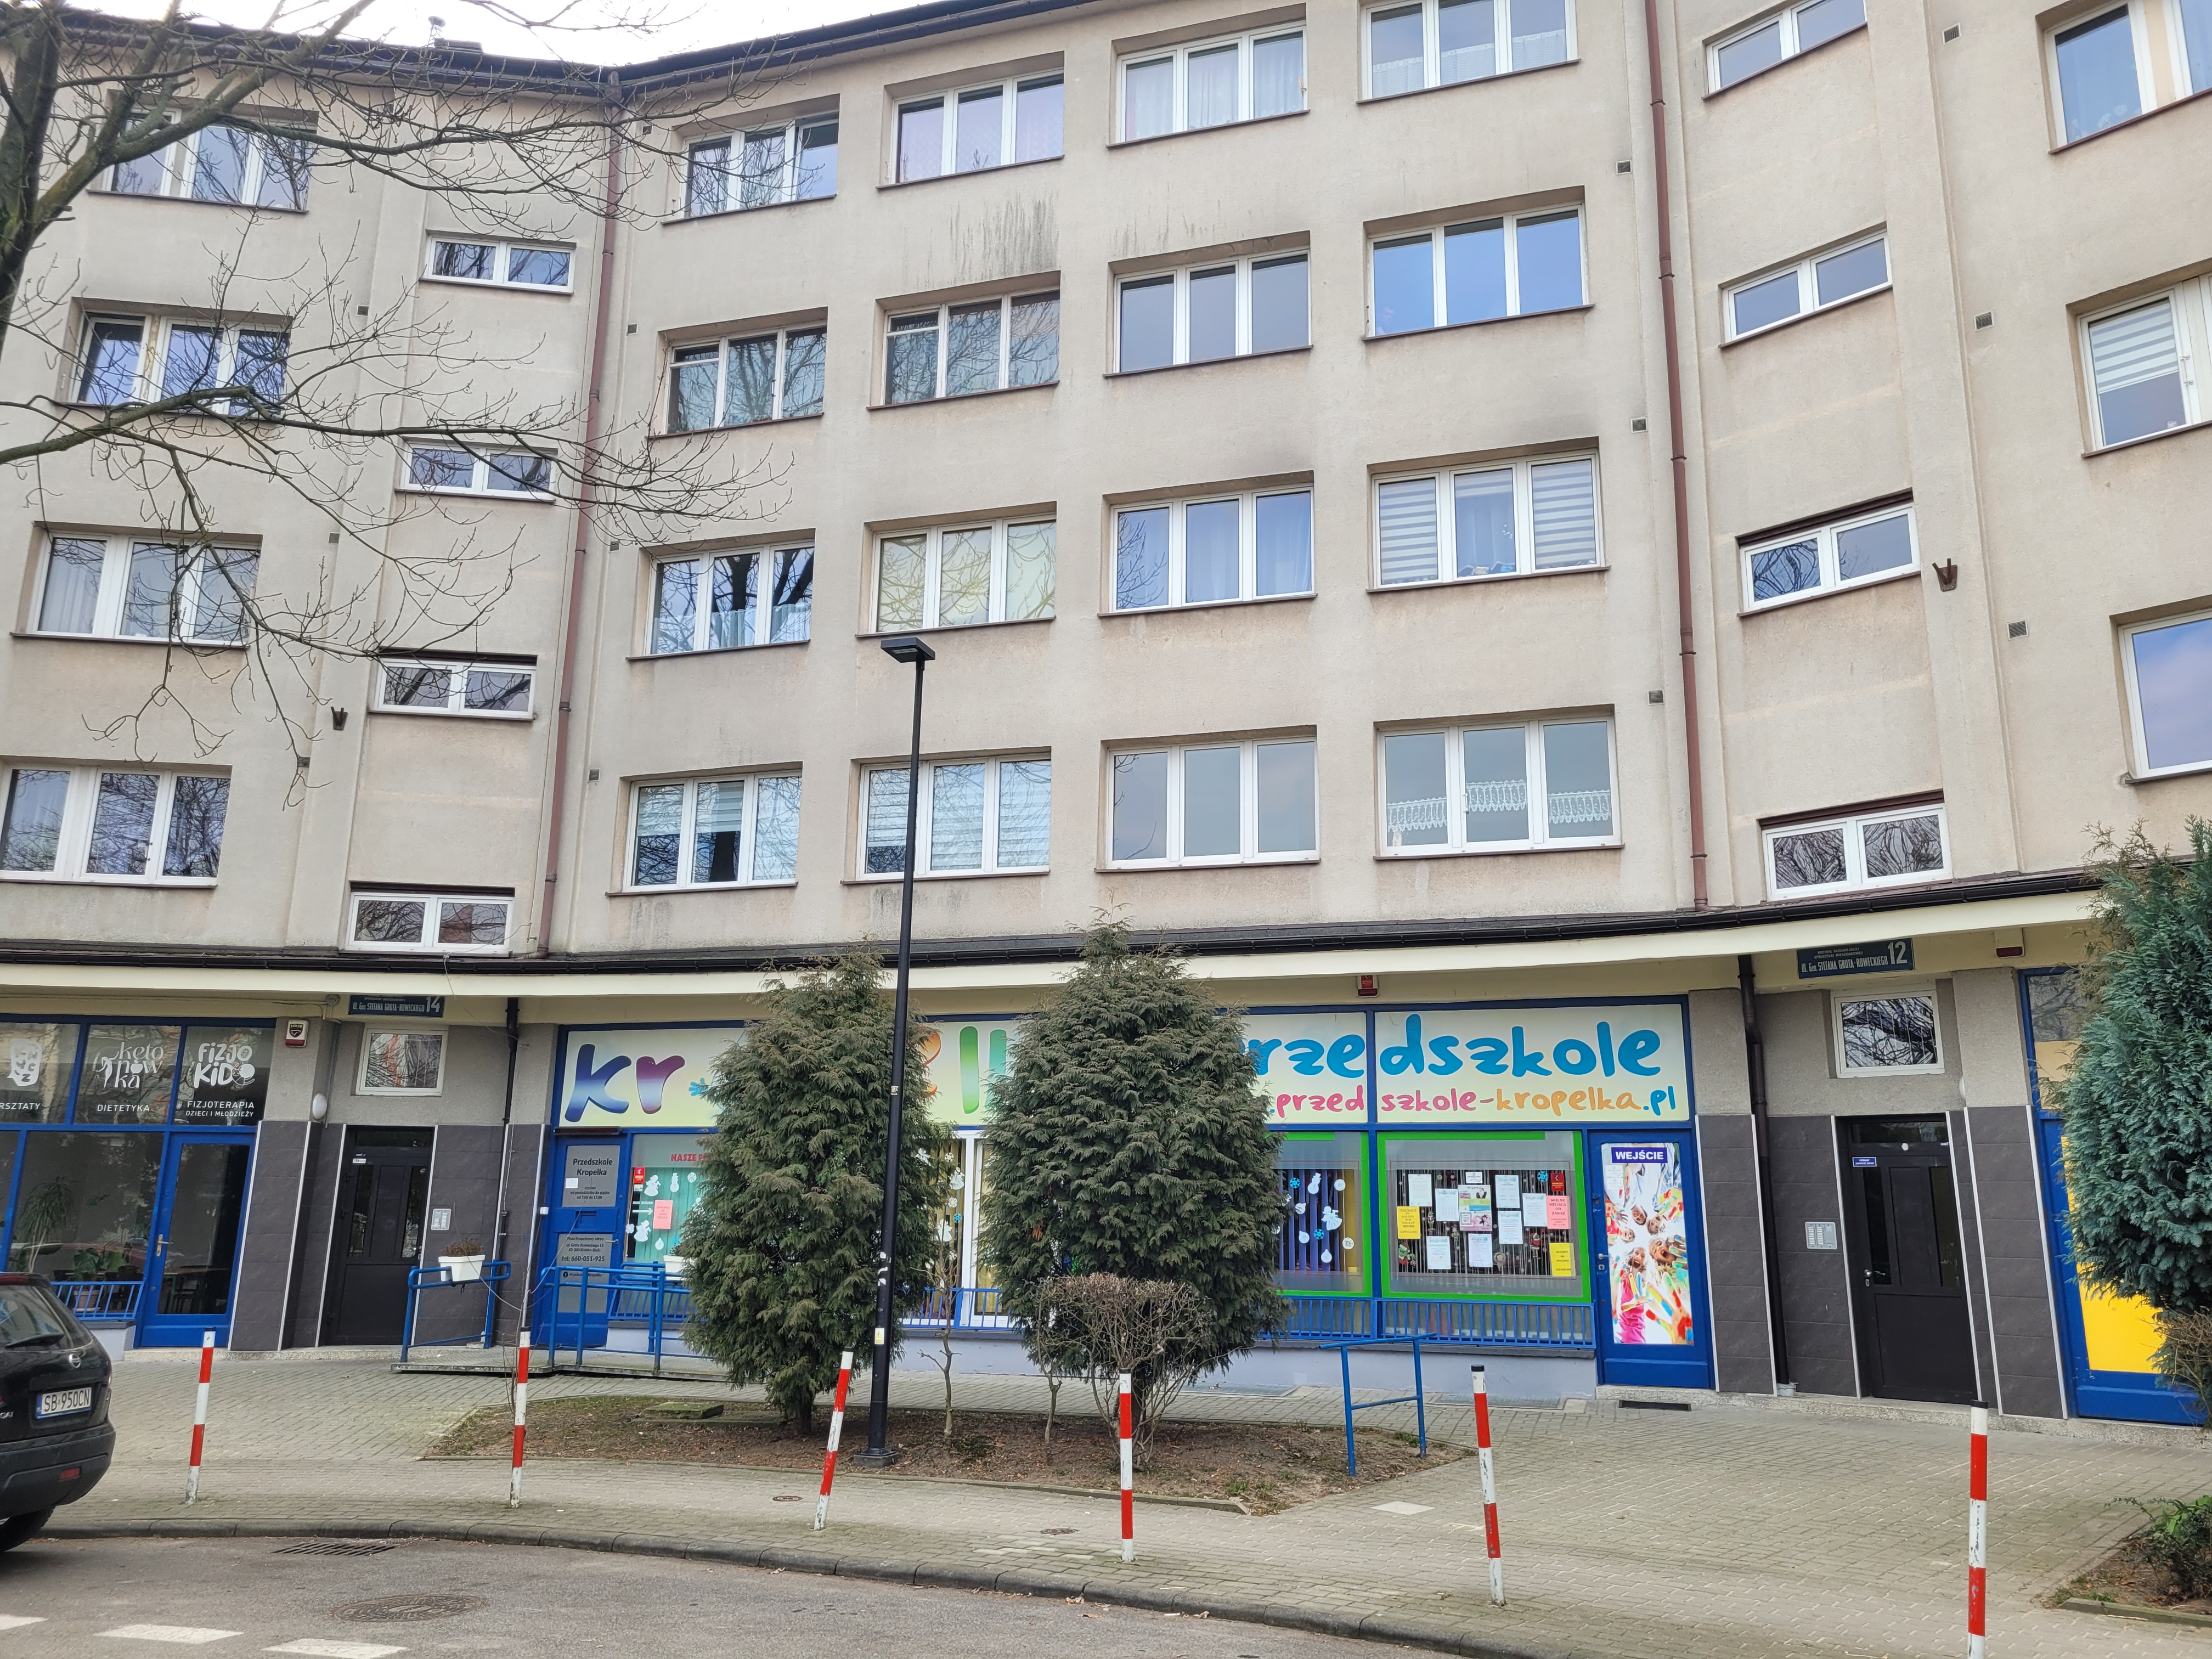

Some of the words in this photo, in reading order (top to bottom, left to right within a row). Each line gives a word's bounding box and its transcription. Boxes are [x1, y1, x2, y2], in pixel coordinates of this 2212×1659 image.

[1818, 960, 1837, 972] STEFANA
[1887, 941, 1908, 964] 12
[366, 1002, 383, 1011] STEFANA
[426, 996, 440, 1013] 14
[187, 1101, 254, 1109] FIZJOTERAPIA
[1615, 1150, 1664, 1160] WEJŚCIE
[577, 1169, 607, 1177] Kropelka
[44, 1394, 57, 1412] SB
[61, 1389, 91, 1409] 950CN
